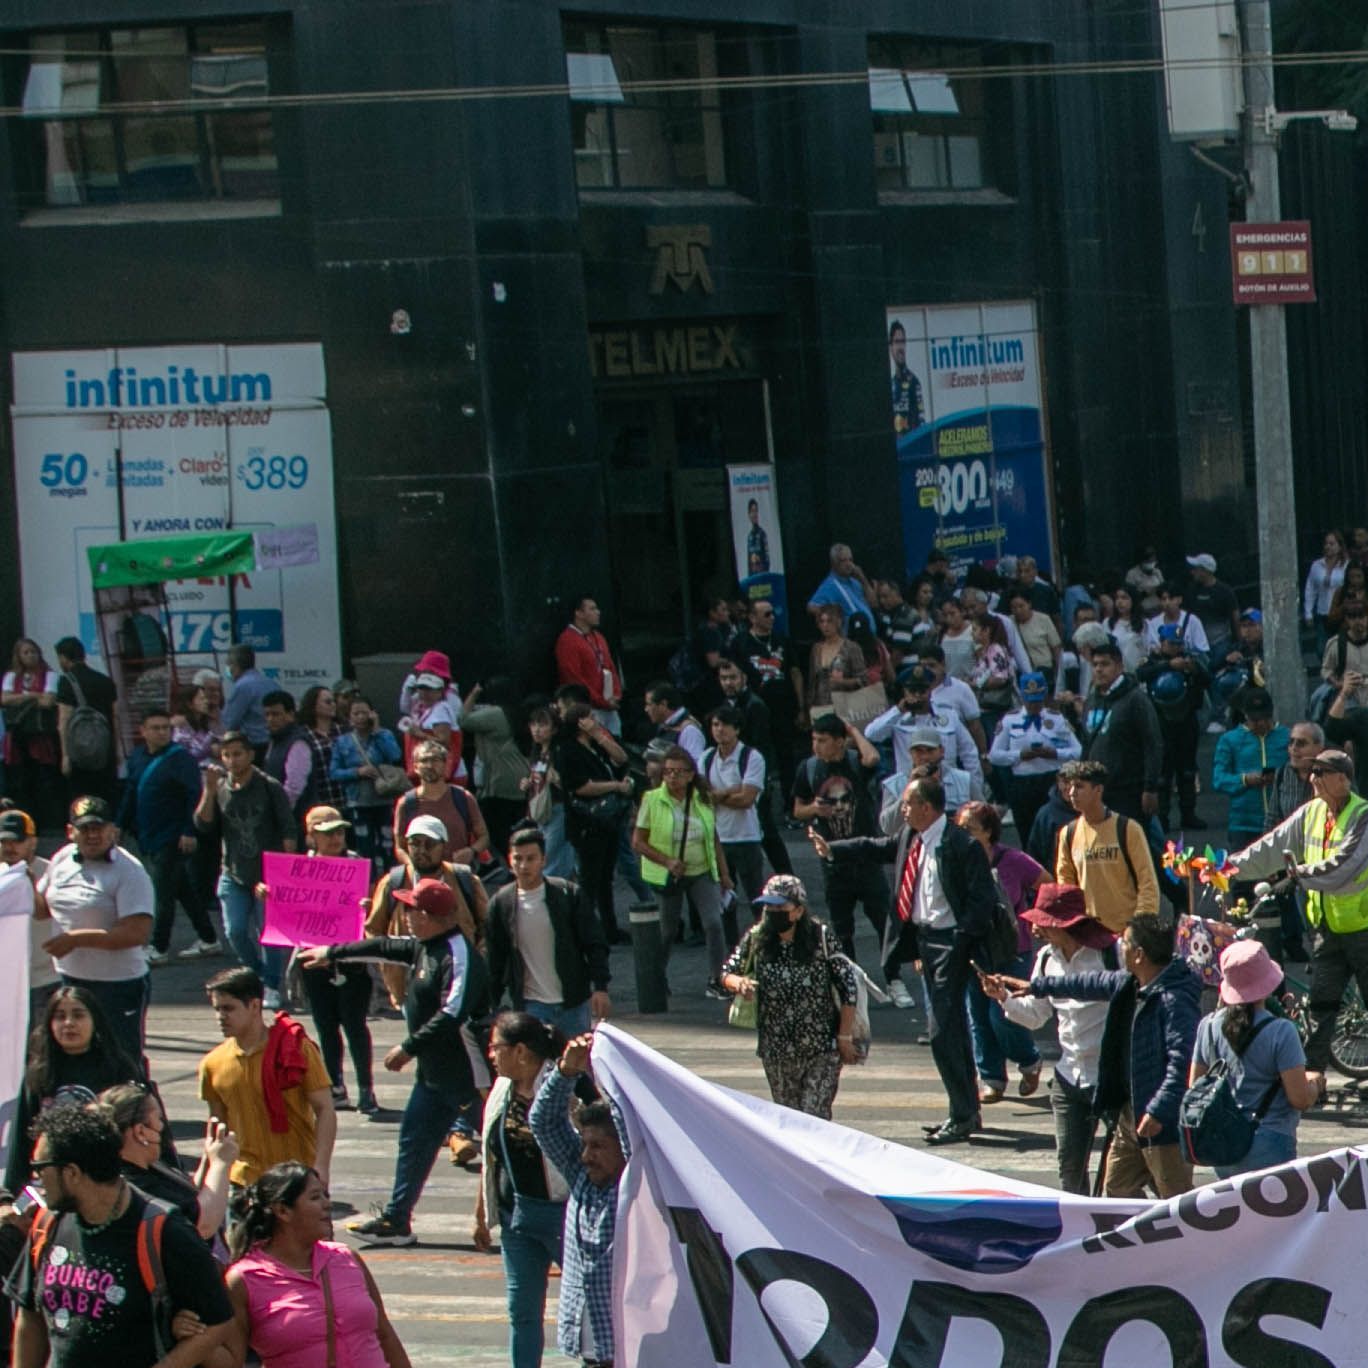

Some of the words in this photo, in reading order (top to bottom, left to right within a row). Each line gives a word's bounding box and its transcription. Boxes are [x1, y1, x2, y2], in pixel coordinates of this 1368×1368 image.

[1236, 233, 1307, 244] EMERGENCIAS
[1243, 255, 1299, 272] 911
[65, 365, 272, 407] infinitum
[40, 453, 88, 487] 50
[179, 458, 223, 474] Claro
[195, 517, 225, 531] CON
[43, 1288, 107, 1319] BABE
